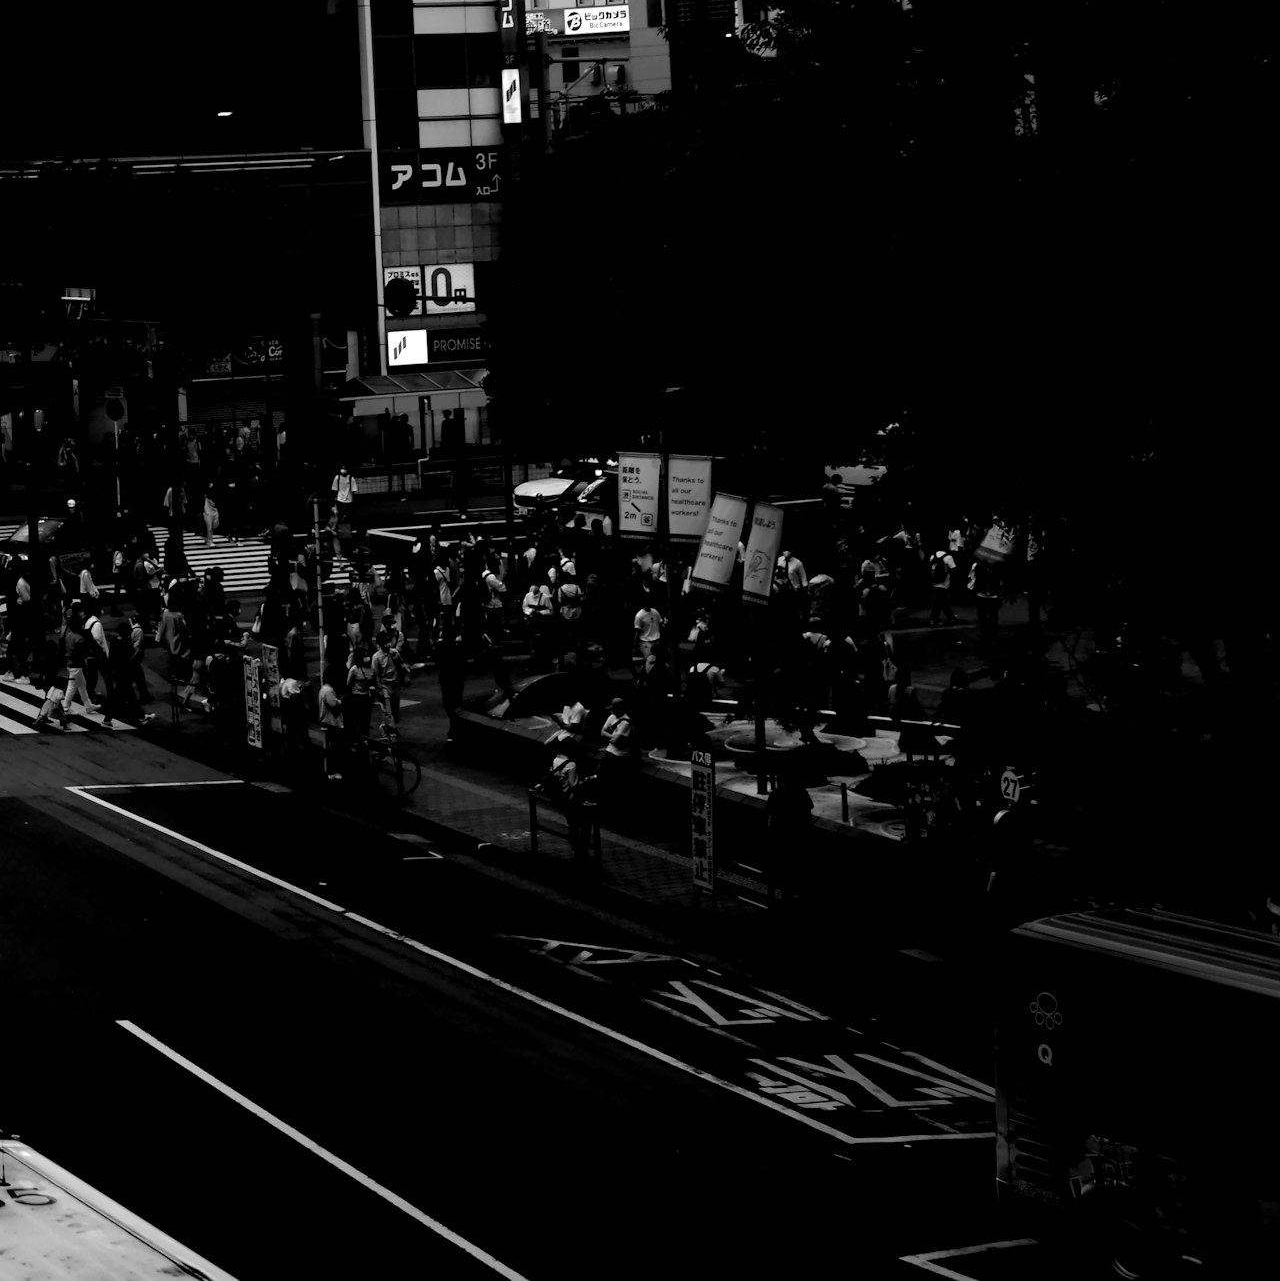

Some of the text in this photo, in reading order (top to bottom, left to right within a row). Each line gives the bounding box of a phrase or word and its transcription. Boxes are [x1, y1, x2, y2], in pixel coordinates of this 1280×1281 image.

[584, 10, 627, 20] ビックカメラ
[504, 54, 515, 65] 3F
[475, 152, 499, 171] 3F
[390, 161, 468, 190] アコム
[433, 337, 482, 353] PROMISE
[671, 498, 706, 506] healthcare
[624, 511, 637, 520] 2m
[692, 750, 712, 767] バス停
[1003, 776, 1018, 799] 27
